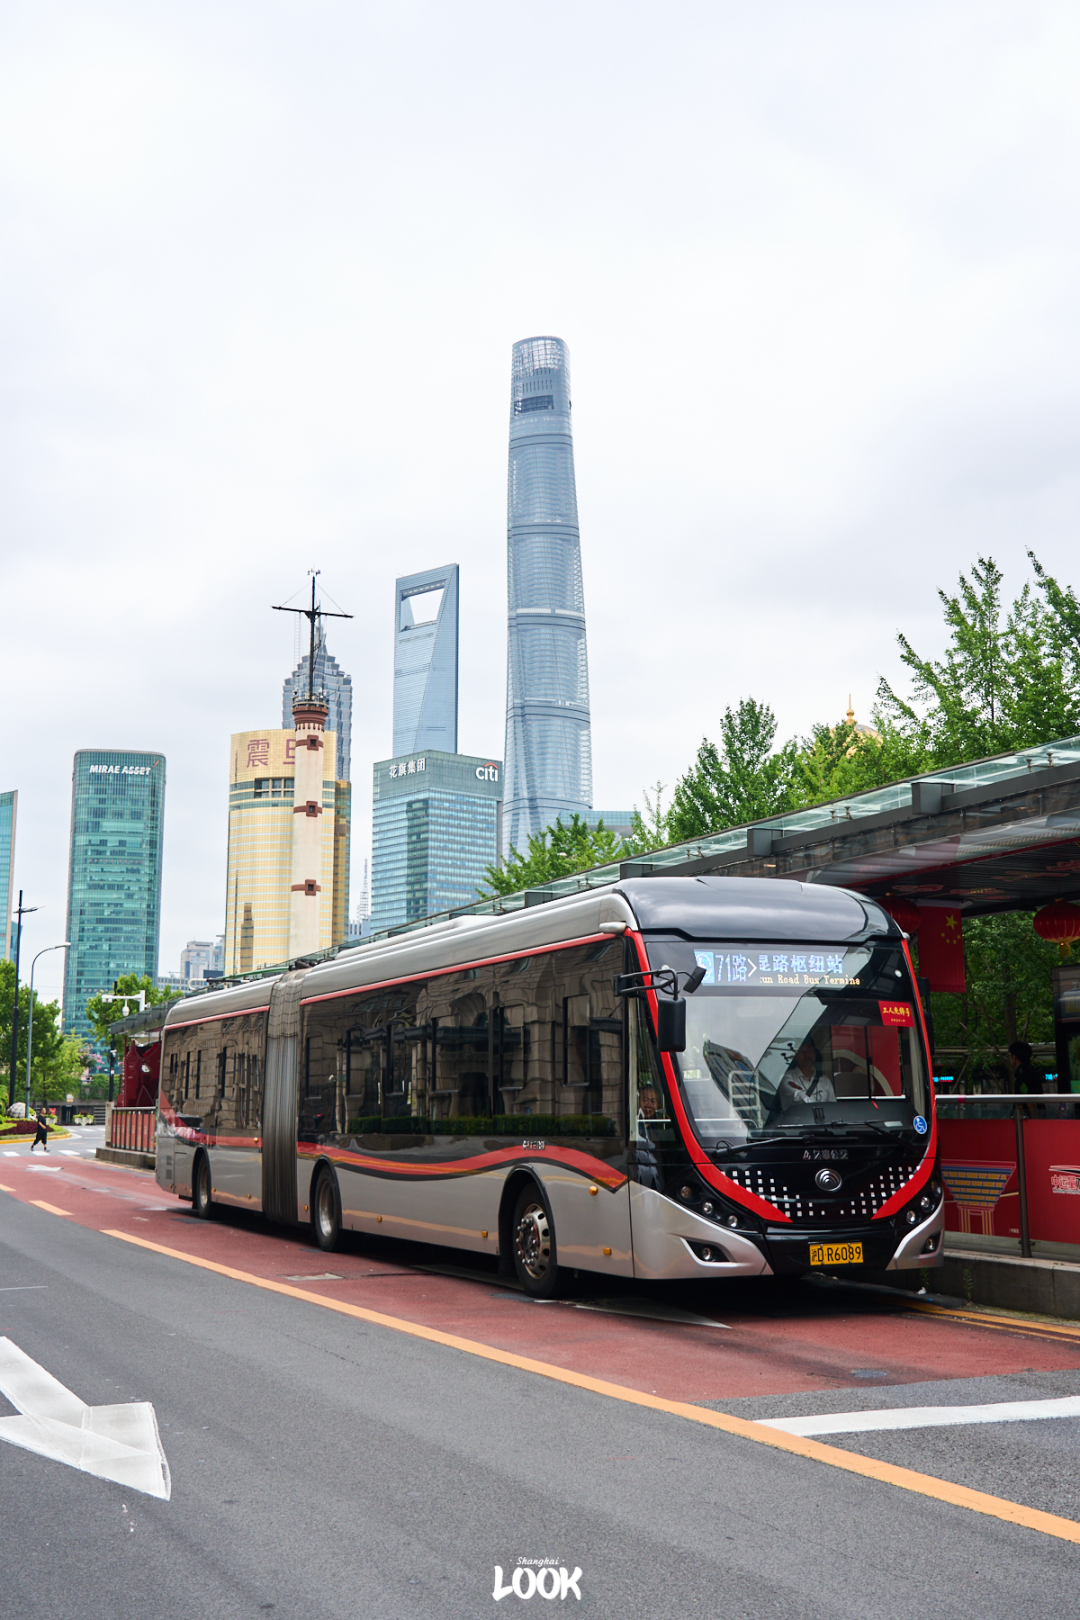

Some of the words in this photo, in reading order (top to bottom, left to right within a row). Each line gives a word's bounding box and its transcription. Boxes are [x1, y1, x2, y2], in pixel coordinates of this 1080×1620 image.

[89, 765, 121, 774] MIRAE
[121, 766, 152, 776] ASSET
[388, 758, 426, 779] 花旗集团
[475, 763, 499, 782] citi
[715, 953, 748, 982] 71路
[777, 974, 800, 984] Road
[803, 974, 820, 985] Bus
